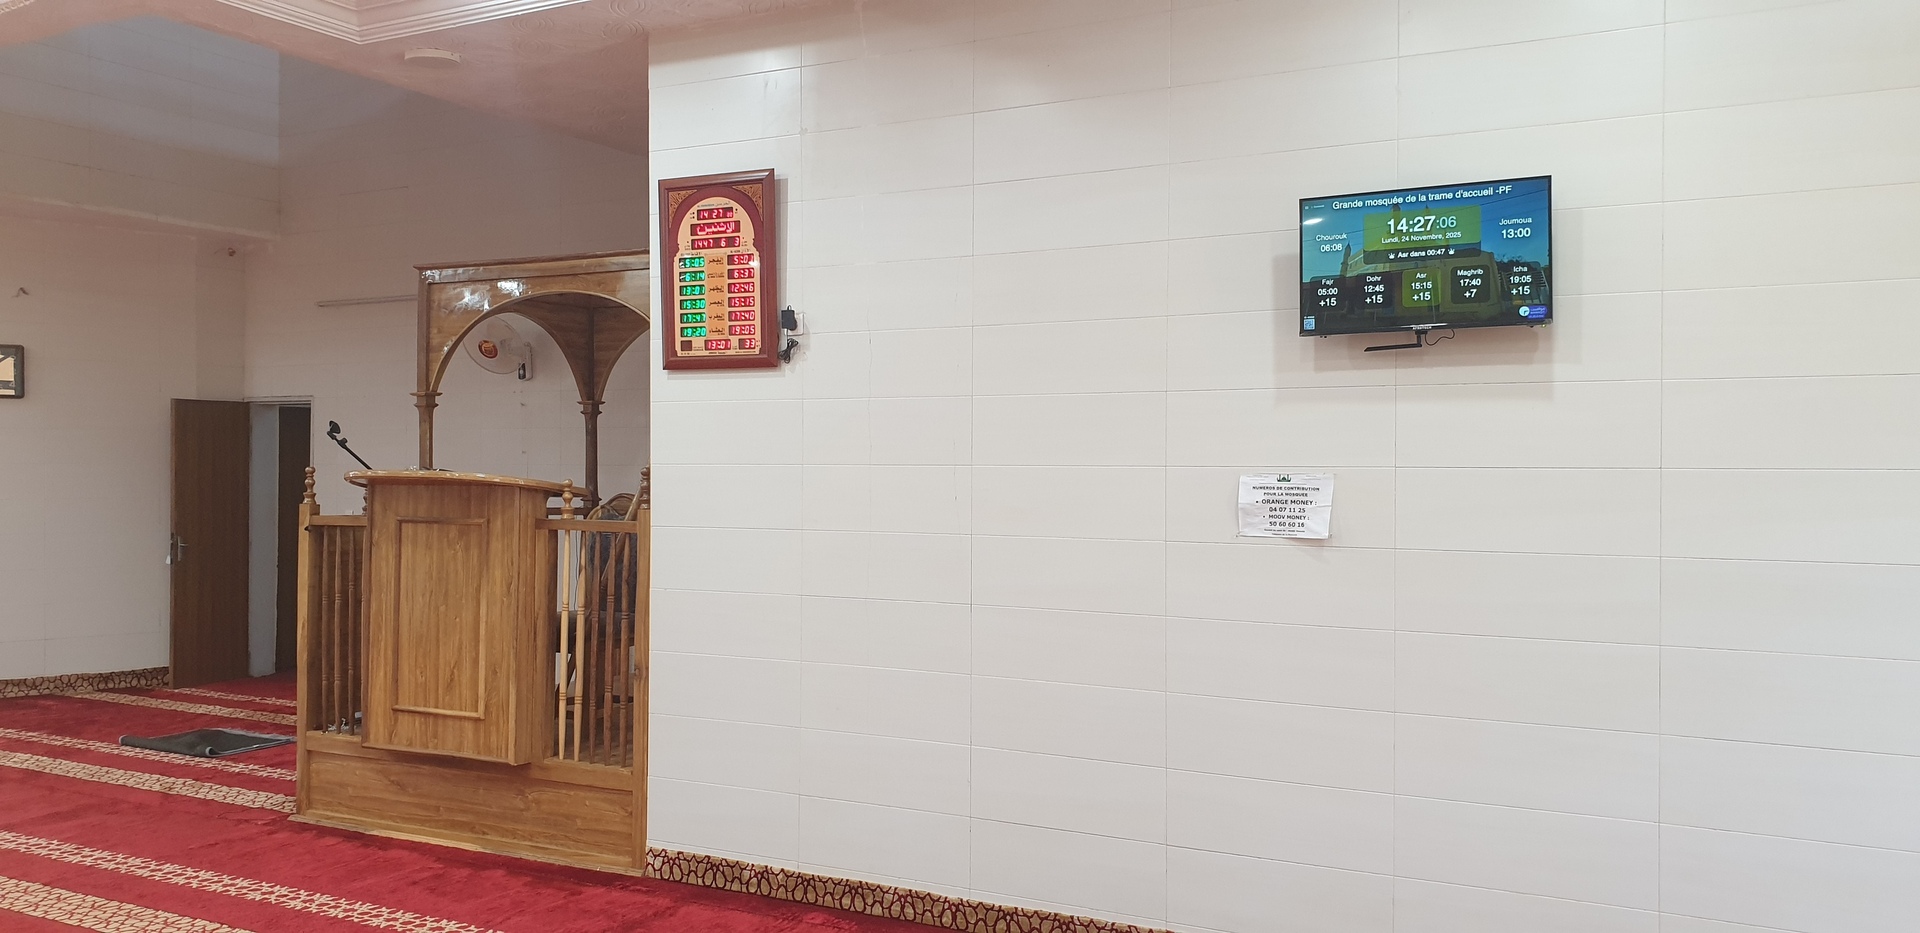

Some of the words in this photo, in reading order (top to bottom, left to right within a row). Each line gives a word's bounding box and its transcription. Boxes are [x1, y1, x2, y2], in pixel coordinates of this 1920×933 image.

[1332, 201, 1362, 210] Grande
[1365, 196, 1403, 207] mosquée
[1406, 194, 1416, 202] de
[1428, 192, 1453, 200] trame
[1456, 187, 1493, 198] d'accueil
[1496, 186, 1512, 194] -PF
[1387, 216, 1456, 234] 14:27:06
[1498, 217, 1532, 226] Joumoua
[1316, 232, 1348, 242] Chourouk
[1501, 228, 1531, 238] 13:00
[694, 239, 713, 248] 1447
[720, 238, 726, 247] 6
[734, 237, 740, 246] 3
[1382, 236, 1400, 244] Lundi,
[1410, 234, 1444, 242] Novembre,
[1320, 244, 1342, 252] 06:08
[734, 268, 754, 278] 6:37
[1457, 268, 1484, 277] Maghrib
[1460, 278, 1482, 287] 17:40
[1510, 275, 1532, 284] 19:05
[732, 284, 754, 292] 12:46
[1364, 284, 1384, 293] 12:45
[1411, 282, 1432, 290] 15:15
[1511, 286, 1530, 295] +15
[1318, 288, 1338, 296] 05:00
[1412, 292, 1431, 301] +15
[1464, 289, 1478, 298] +7
[732, 297, 754, 306] 15:15
[1319, 298, 1336, 306] +15
[1364, 294, 1383, 304] +15
[732, 311, 754, 320] 17:40
[732, 326, 754, 334] 19:05
[708, 340, 730, 349] 13:01
[744, 340, 755, 348] 33
